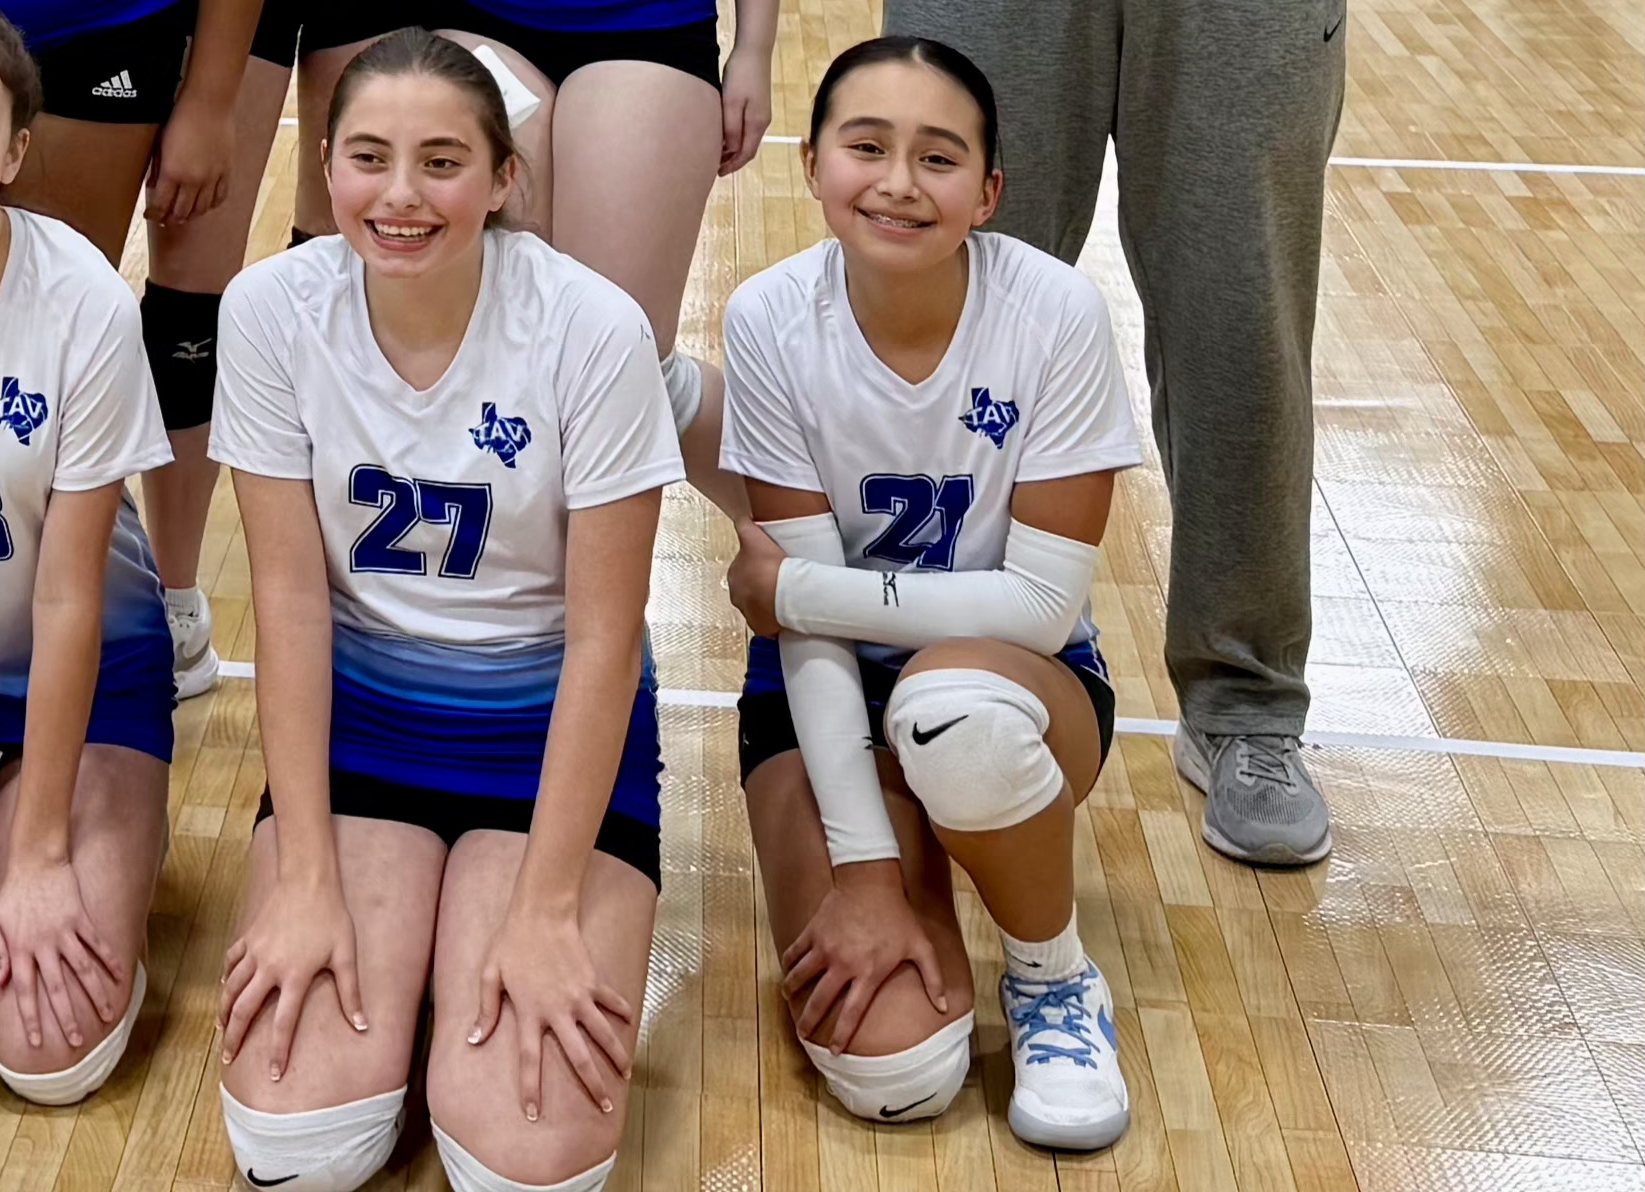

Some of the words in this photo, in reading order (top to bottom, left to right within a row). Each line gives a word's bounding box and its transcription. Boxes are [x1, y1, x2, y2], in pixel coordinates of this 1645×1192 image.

[91, 85, 138, 98] adidas
[475, 419, 524, 444] TAV
[347, 462, 494, 581] 27
[859, 472, 975, 573] 21
